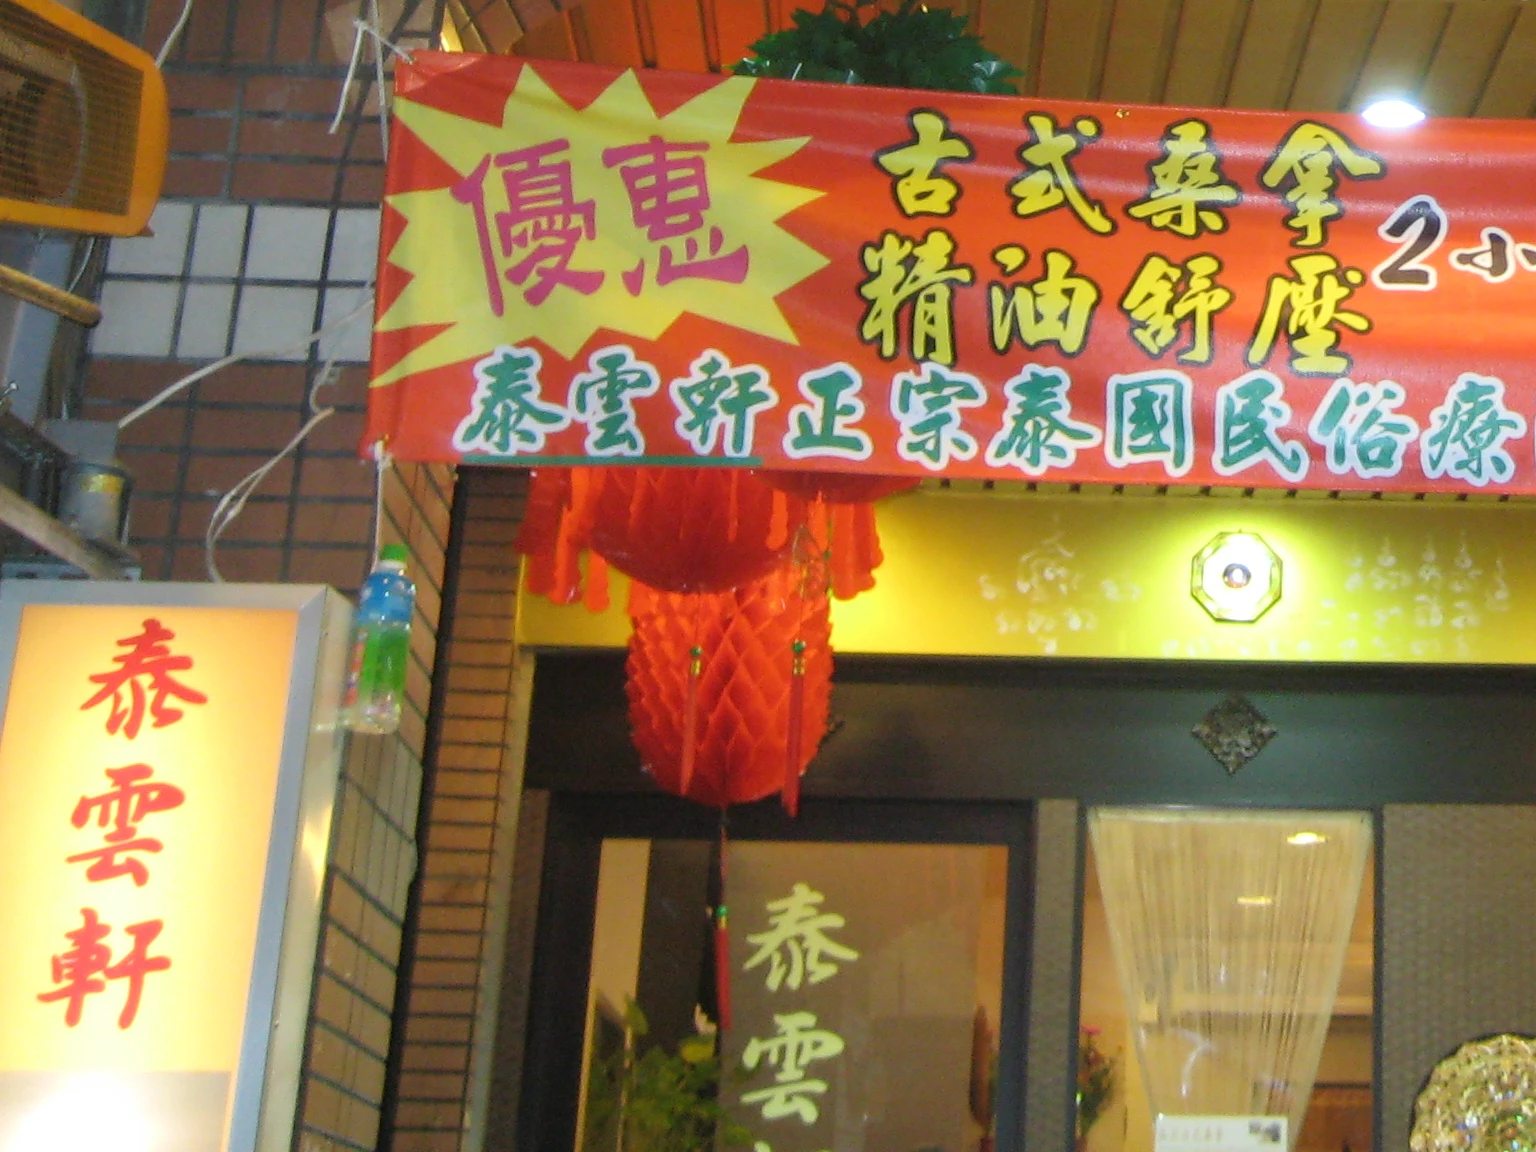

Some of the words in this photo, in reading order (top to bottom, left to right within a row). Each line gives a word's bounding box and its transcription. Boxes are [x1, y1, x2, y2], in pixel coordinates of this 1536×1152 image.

[450, 136, 750, 316] 優惠
[876, 108, 1384, 246] 古式桑拿
[857, 226, 1374, 378] 精油舒壓
[36, 618, 209, 1030] 泰雲軒
[740, 882, 861, 1152] 泰雲
